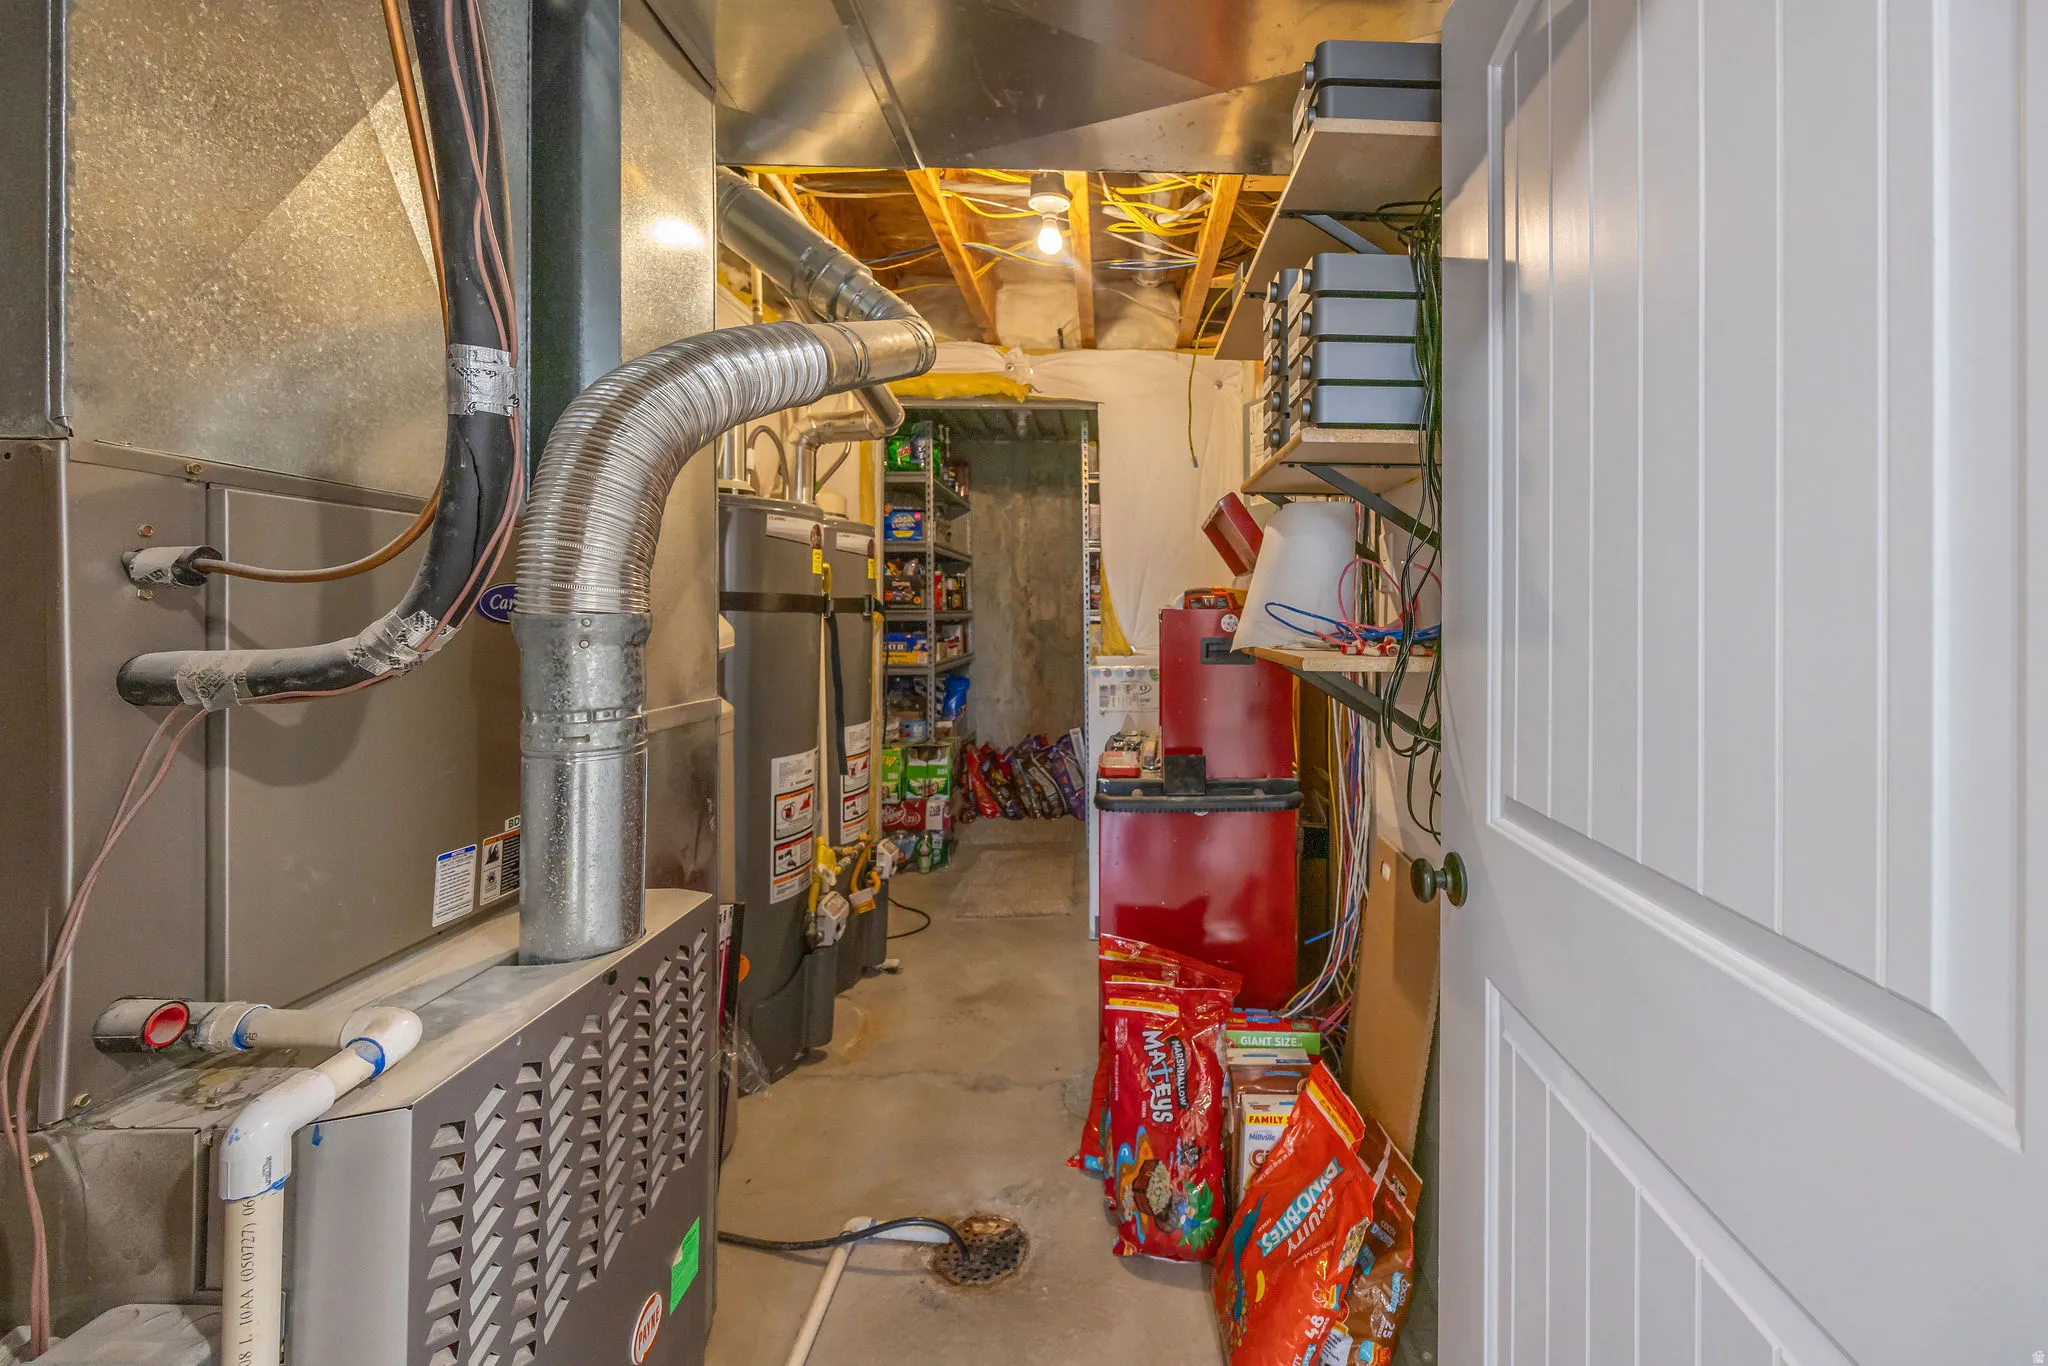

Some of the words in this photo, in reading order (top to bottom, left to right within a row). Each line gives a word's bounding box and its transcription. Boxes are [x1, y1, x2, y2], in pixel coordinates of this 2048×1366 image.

[1240, 1036, 1272, 1046] GIANT
[1274, 1037, 1297, 1047] SIZE
[1141, 1030, 1174, 1124] MATEYS
[1171, 1040, 1188, 1107] MARSHMALLOW
[1248, 1115, 1283, 1124] FAMILY
[1248, 1132, 1276, 1142] Millville
[242, 1199, 256, 1216] 06
[1287, 1187, 1335, 1257] FRUITY
[241, 1222, 257, 1283] (050727)
[637, 1306, 661, 1350] PAYNE
[1304, 1314, 1325, 1339] 48
[1382, 1321, 1396, 1338] 25
